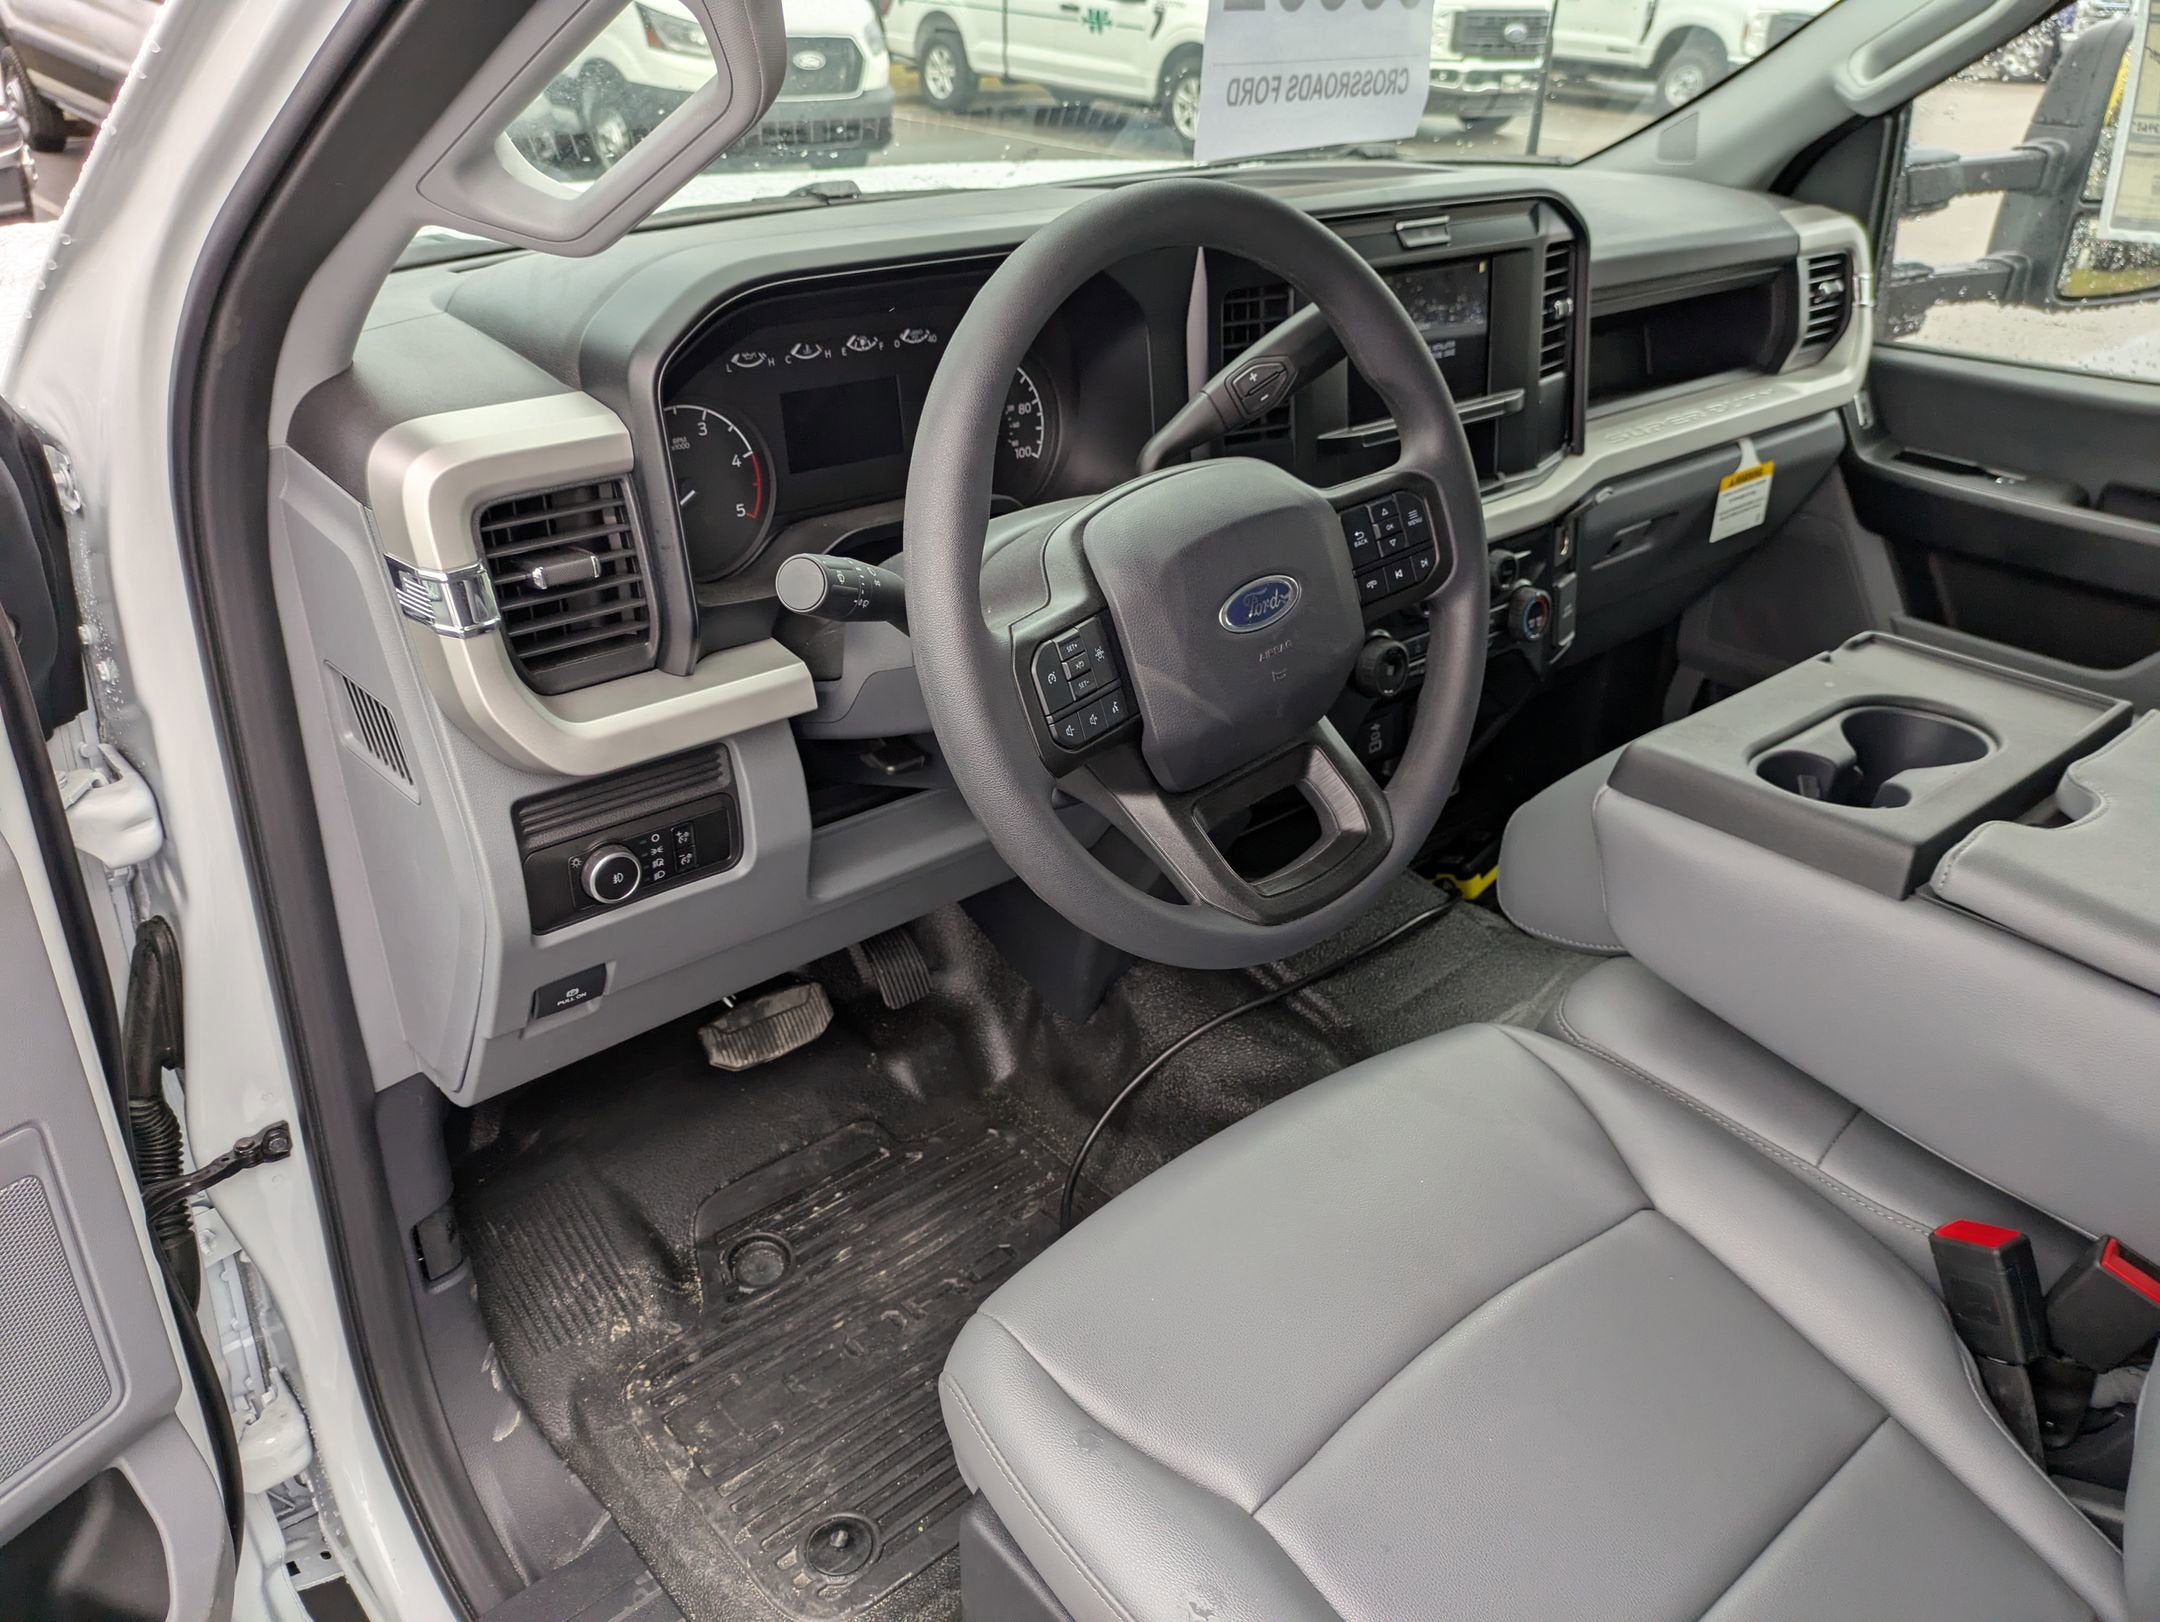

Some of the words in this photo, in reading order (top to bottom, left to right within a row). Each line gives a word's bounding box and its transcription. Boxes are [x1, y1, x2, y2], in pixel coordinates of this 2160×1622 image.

[824, 349, 832, 359] H
[841, 346, 848, 357] E
[767, 357, 776, 367] H
[785, 355, 792, 365] C
[726, 363, 733, 373] L
[1018, 402, 1032, 415] 80
[697, 422, 708, 436] 3
[1605, 408, 1706, 445] SUPER
[1014, 446, 1032, 459] 100
[731, 454, 742, 468] 4
[736, 503, 746, 517] 5
